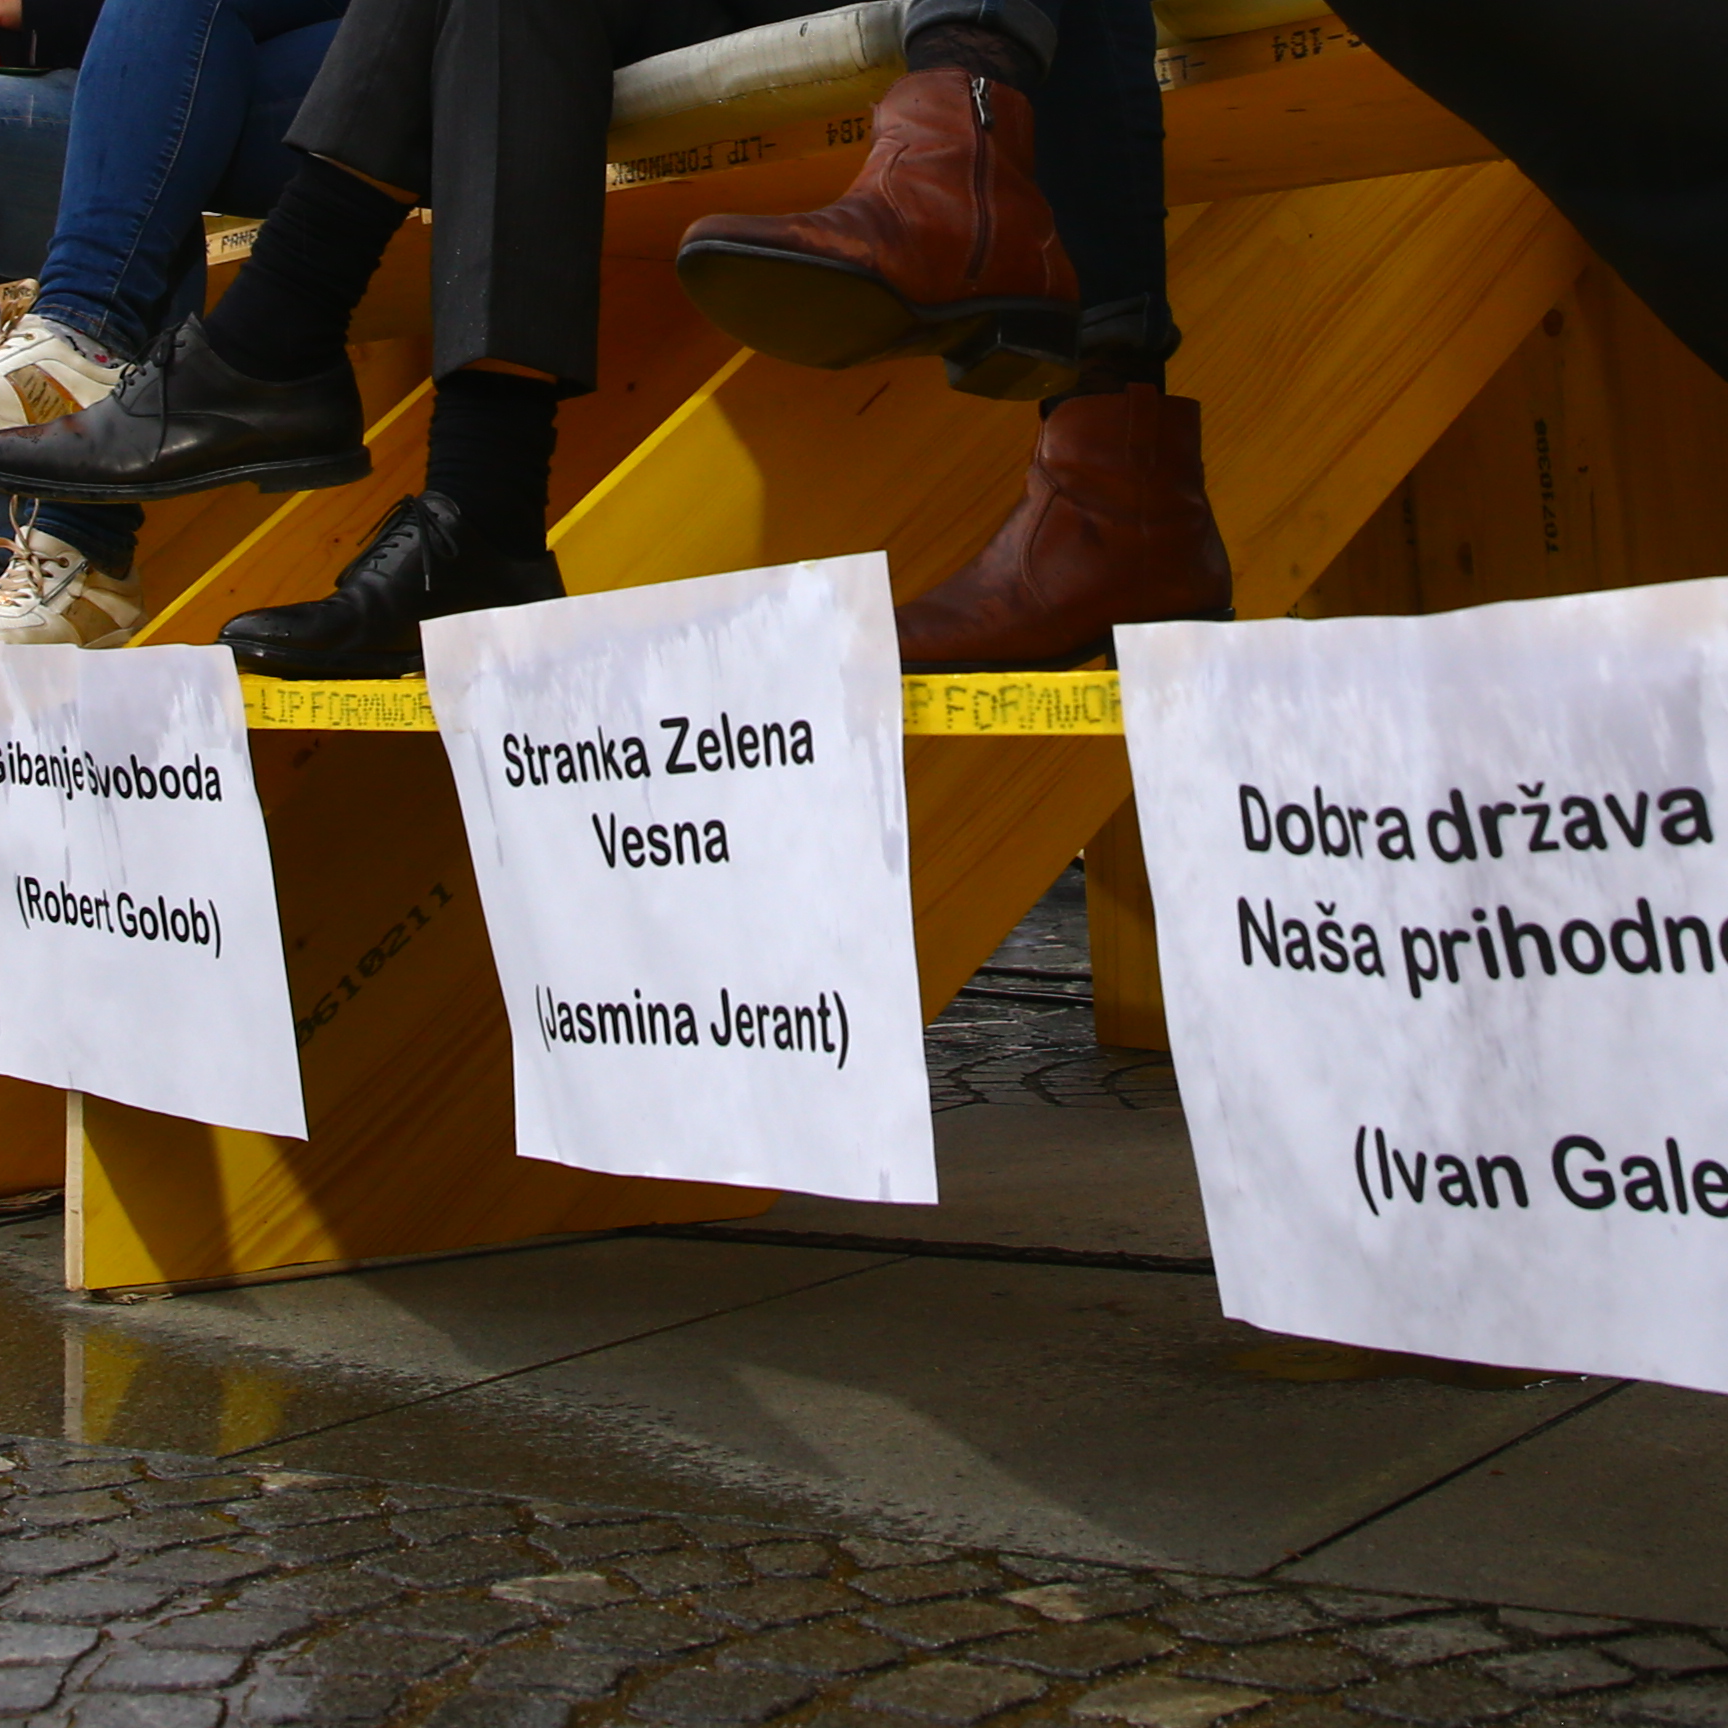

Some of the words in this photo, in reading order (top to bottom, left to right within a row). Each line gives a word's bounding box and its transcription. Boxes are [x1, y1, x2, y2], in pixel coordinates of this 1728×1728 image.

[84, 750, 223, 802] Svoboda
[503, 725, 651, 788] Stranka
[659, 711, 814, 775] Zelena
[592, 812, 730, 869] Vesna
[1239, 784, 1416, 861] Dobra
[1427, 781, 1714, 864] država
[16, 875, 115, 935] (Robert
[117, 890, 223, 959] Golob)
[1237, 896, 1387, 978] Naša
[536, 984, 699, 1052] (Jasmina
[710, 987, 849, 1070] Jerant)
[1354, 1125, 1530, 1217] (Ivan
